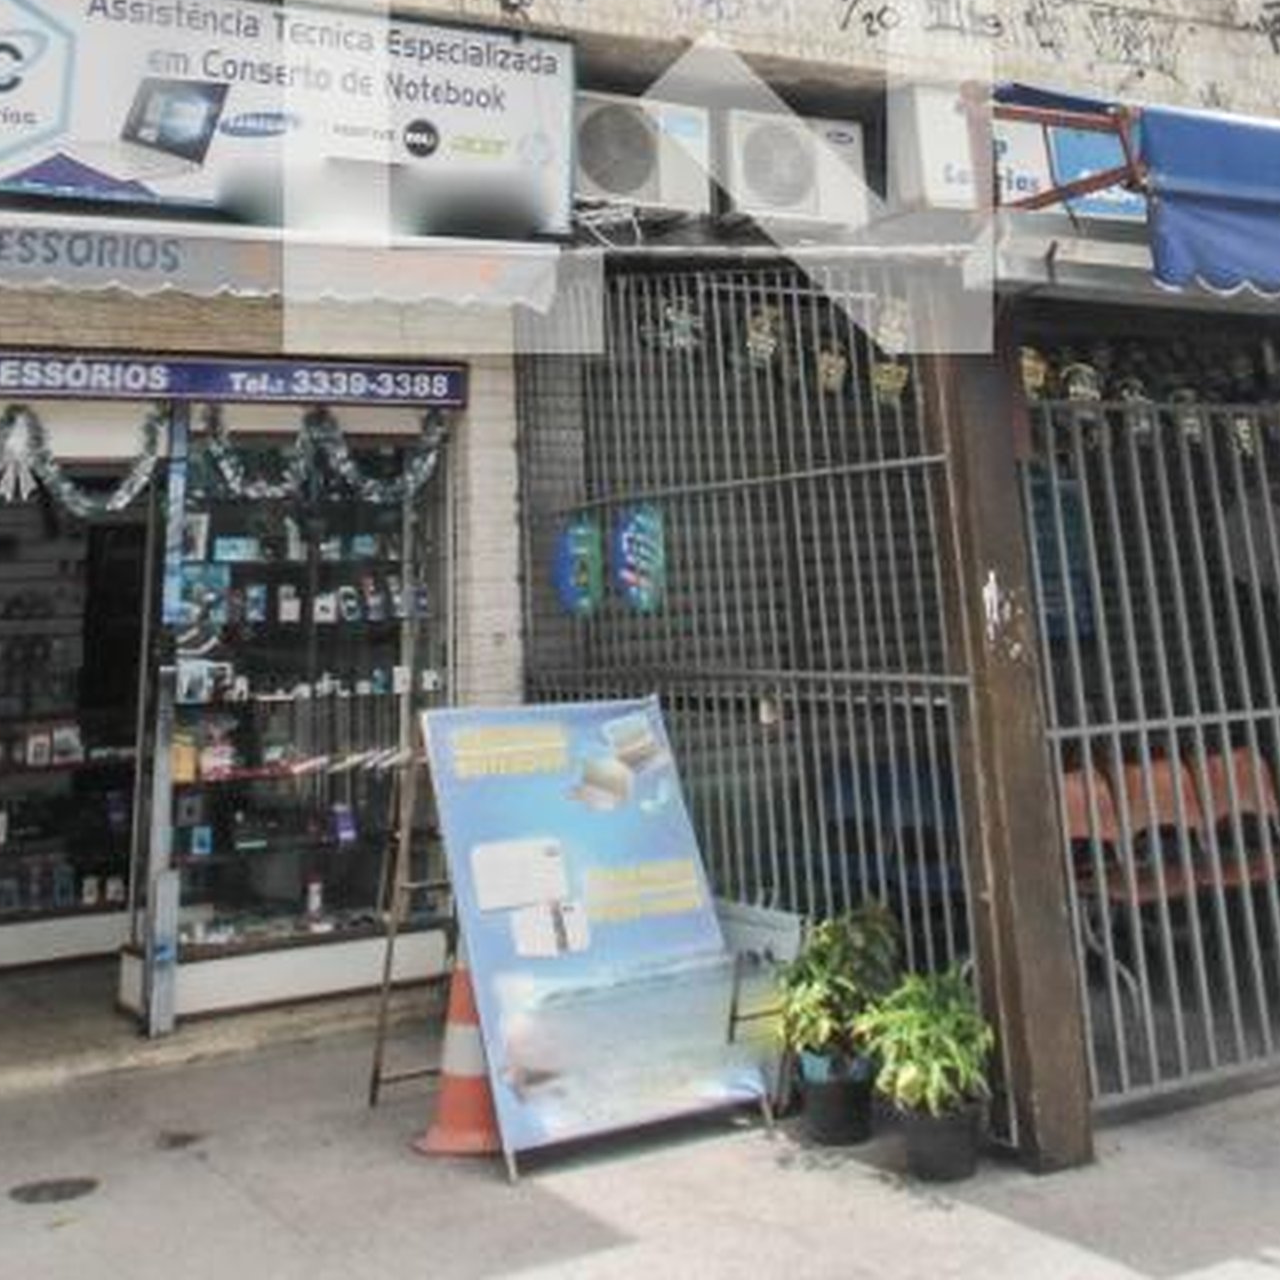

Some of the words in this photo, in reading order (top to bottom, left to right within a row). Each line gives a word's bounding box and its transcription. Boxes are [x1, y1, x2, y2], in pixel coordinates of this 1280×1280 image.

[387, 28, 558, 76] Especializada
[146, 49, 190, 75] em
[202, 49, 335, 92] Conserto
[341, 62, 375, 98] de
[385, 71, 508, 113] Notebook
